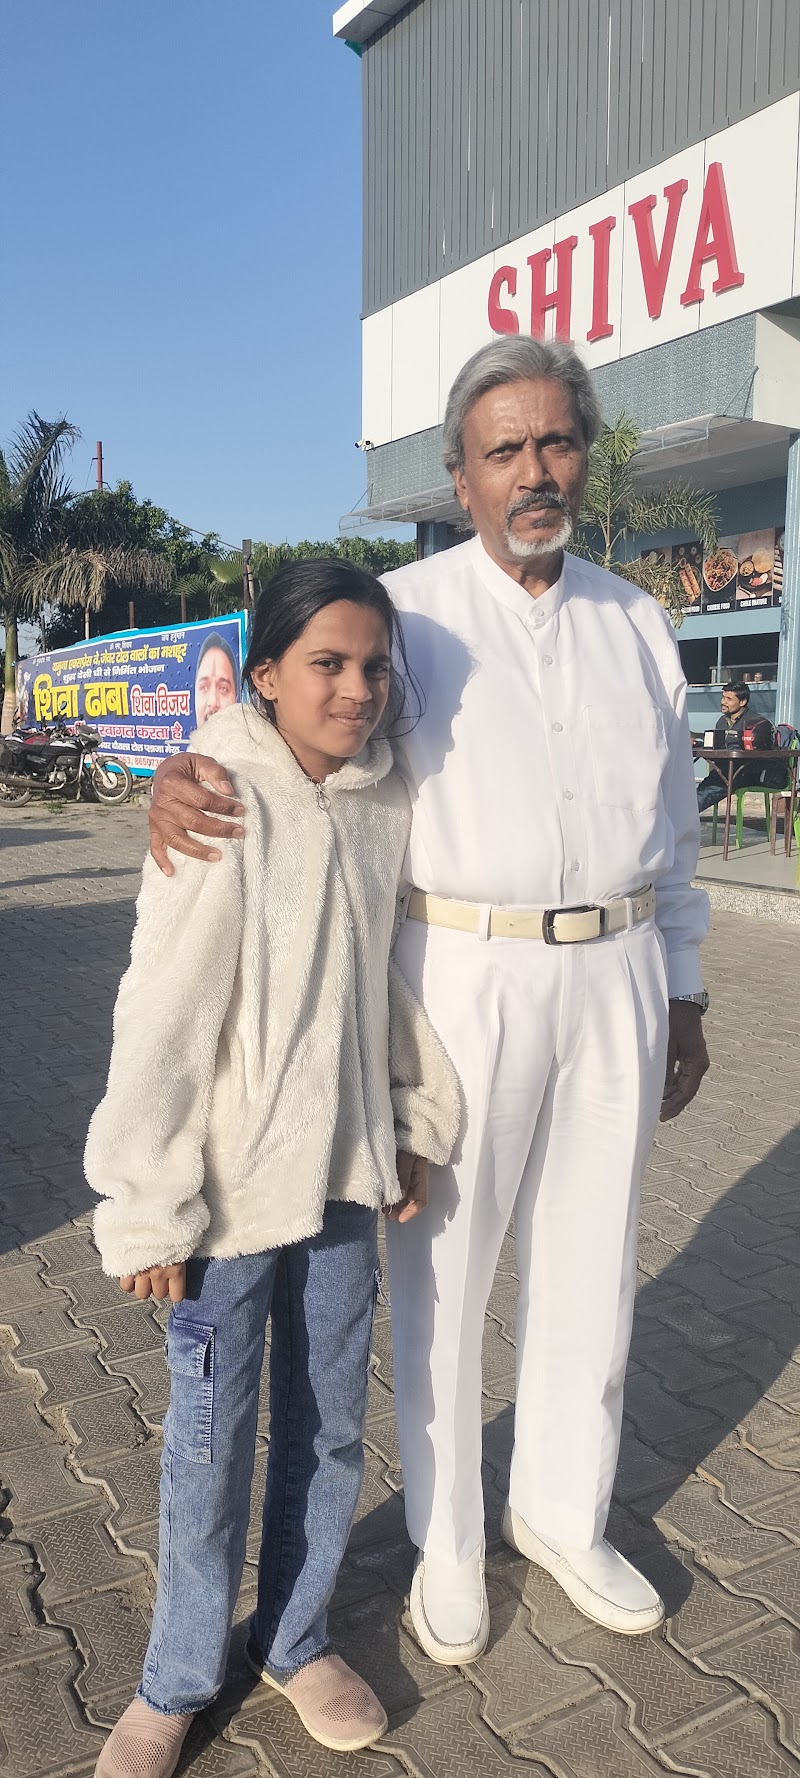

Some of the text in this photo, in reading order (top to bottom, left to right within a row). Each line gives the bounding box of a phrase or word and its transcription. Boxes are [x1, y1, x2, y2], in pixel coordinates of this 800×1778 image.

[488, 161, 745, 347] SHIVA
[116, 647, 129, 663] टोल
[130, 643, 148, 662] वालों
[148, 646, 160, 660] का
[161, 643, 188, 663] मशहूर
[93, 667, 102, 677] घी
[103, 666, 111, 676] से
[138, 663, 165, 674] भोजन
[33, 673, 190, 721] शिवा ढाबा शिवा विजय
[98, 724, 135, 738] स्वागत
[136, 725, 169, 739] करता
[171, 720, 183, 740] है
[131, 741, 143, 752] टोल
